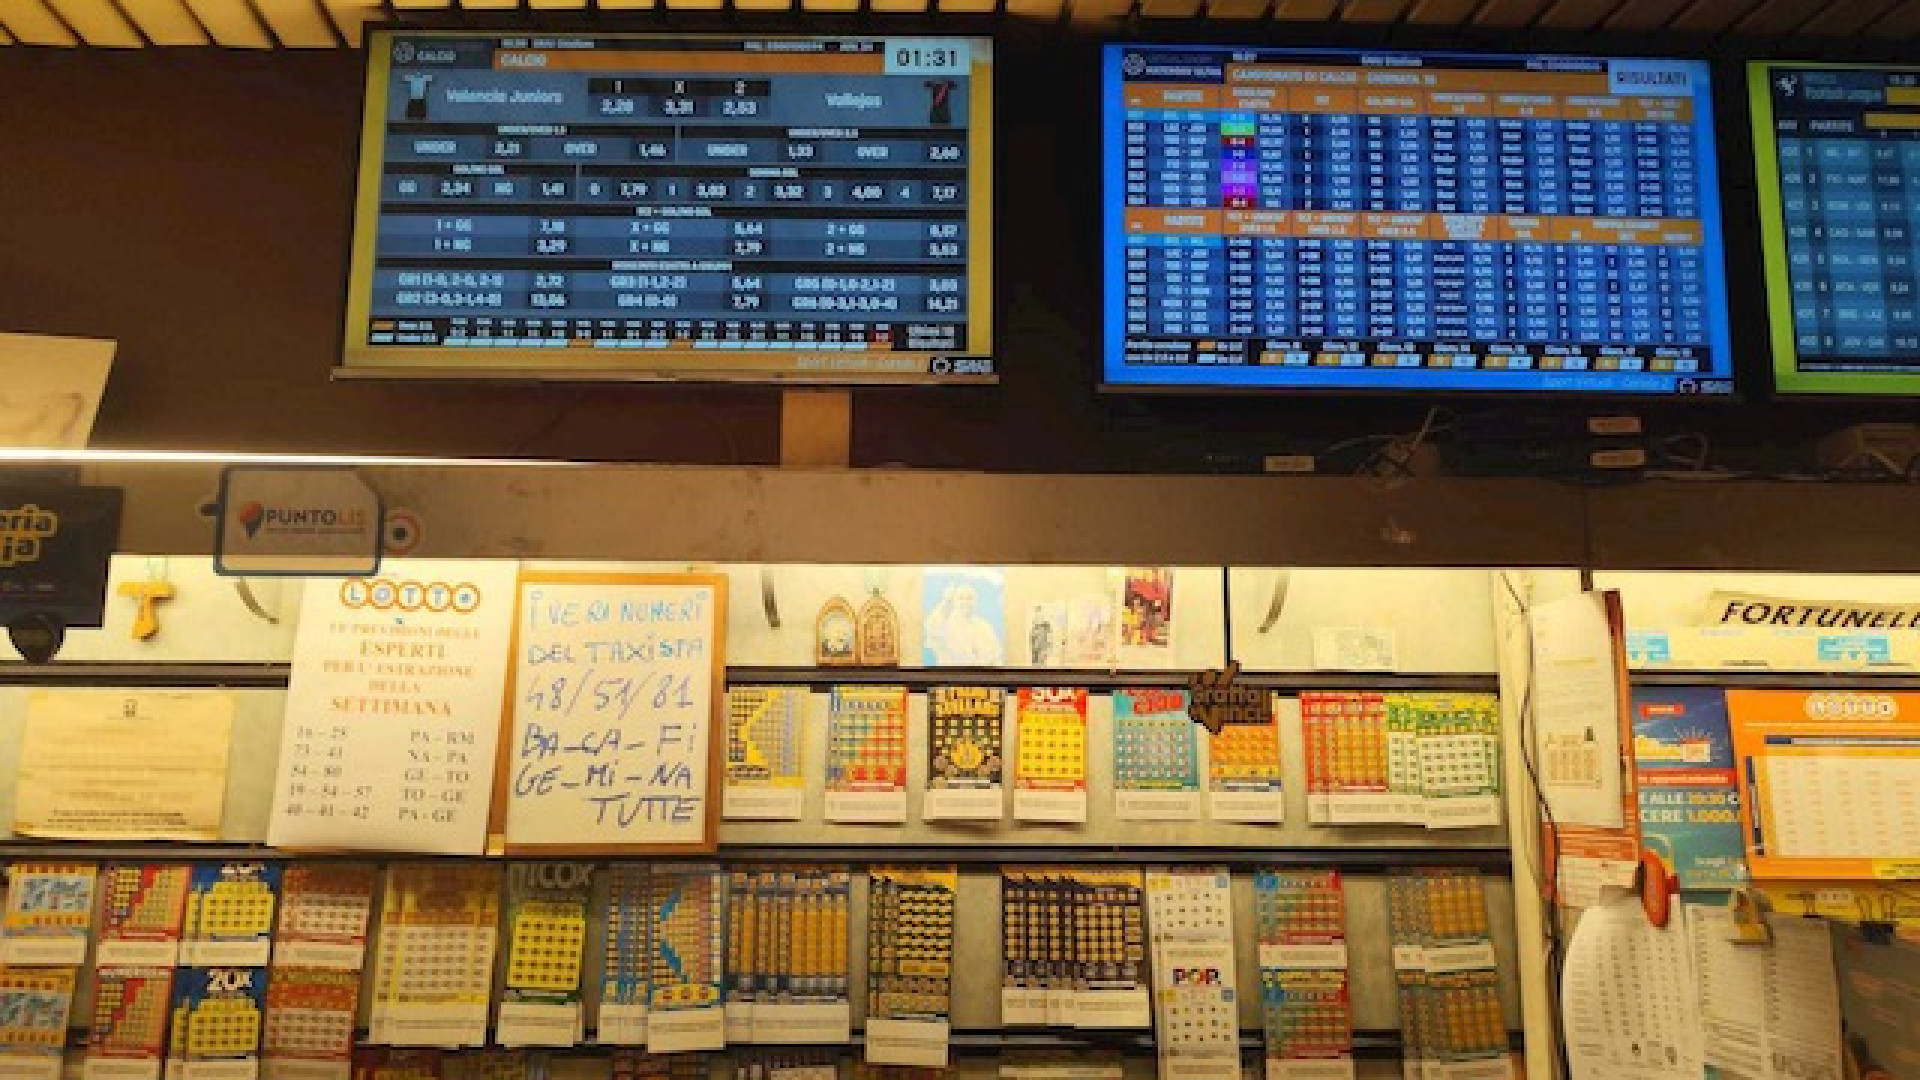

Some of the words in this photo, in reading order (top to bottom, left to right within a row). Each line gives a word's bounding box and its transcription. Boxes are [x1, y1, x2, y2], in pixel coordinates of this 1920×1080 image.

[500, 53, 547, 67] CALCIO
[896, 50, 958, 67] 01:31
[1616, 72, 1687, 86] RISULTATI
[509, 89, 563, 103] Juniors
[414, 141, 456, 153] UNDER
[564, 142, 597, 154] OVER
[707, 144, 748, 157] UNDER
[856, 146, 888, 158] OVER
[341, 580, 480, 613] LOTTO
[360, 643, 446, 659] ESPERTI
[528, 644, 575, 665] DEL
[368, 681, 422, 694] DELLA
[332, 697, 453, 717] SETTIMANA
[584, 792, 701, 828] TUTTE
